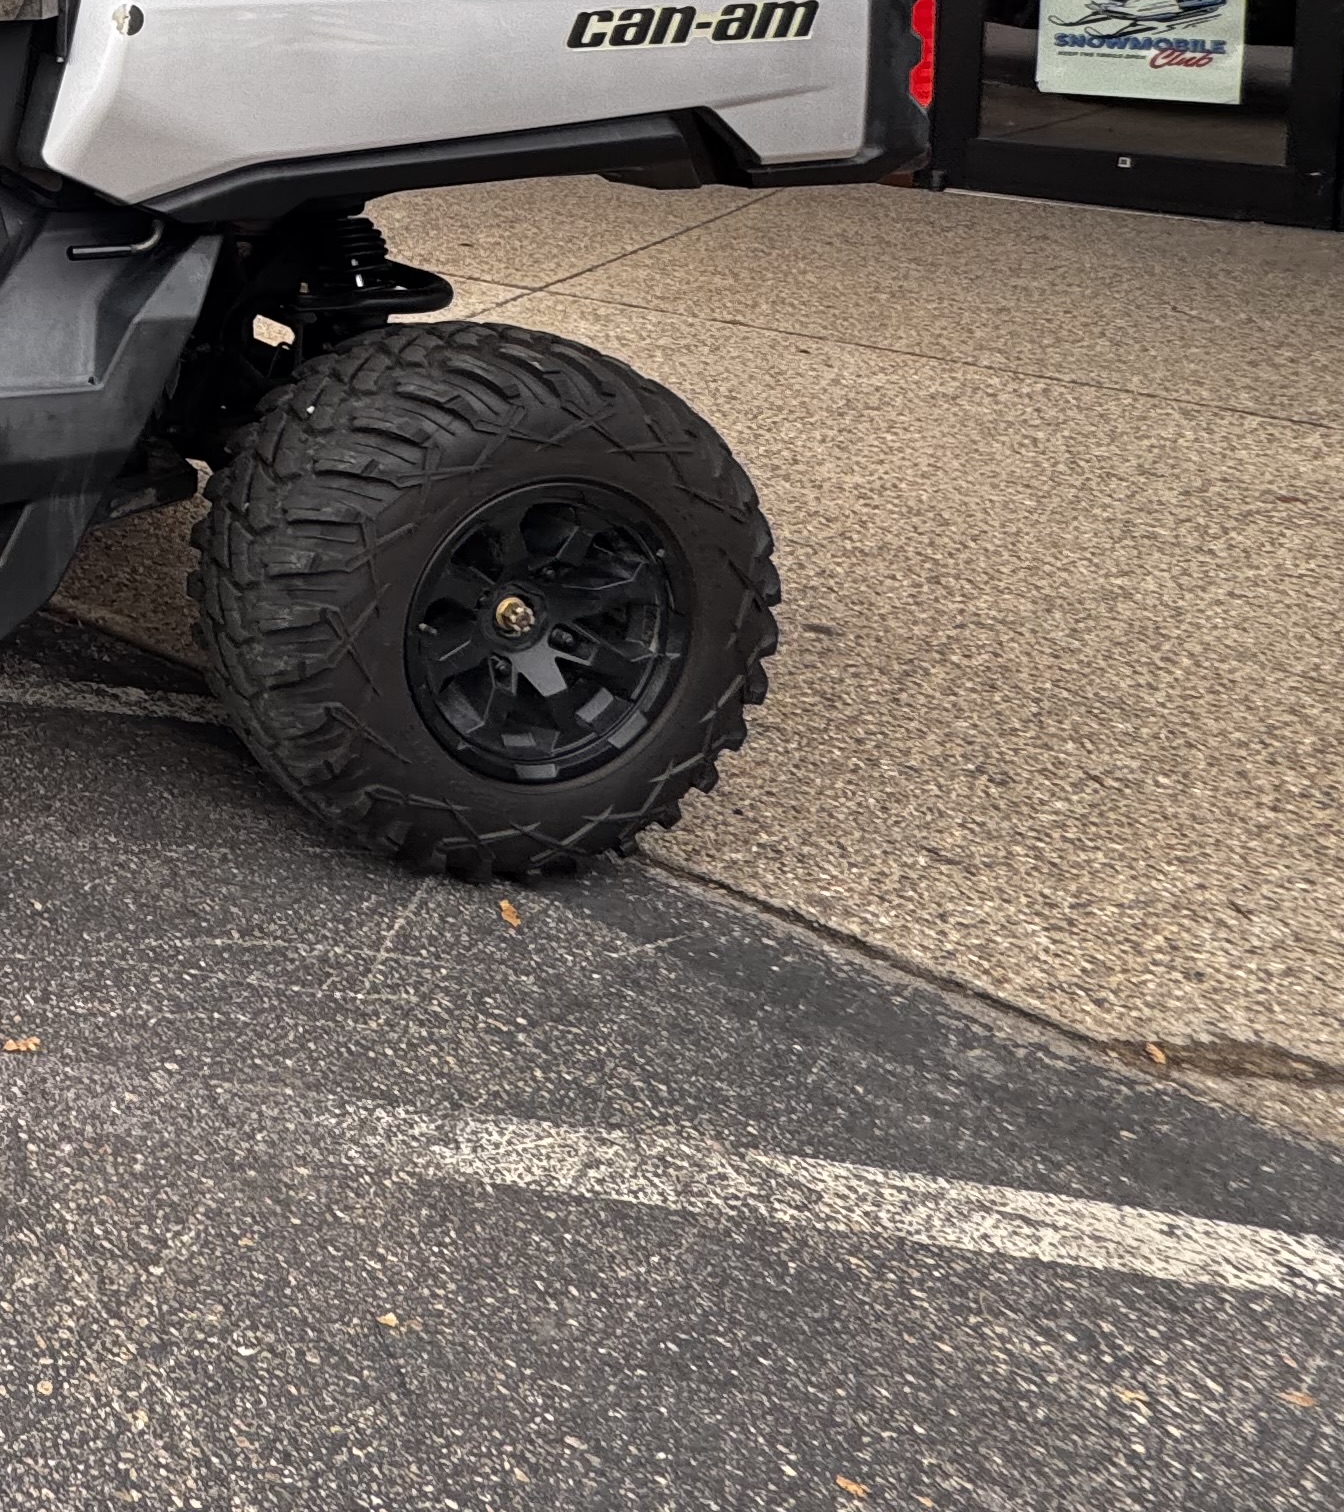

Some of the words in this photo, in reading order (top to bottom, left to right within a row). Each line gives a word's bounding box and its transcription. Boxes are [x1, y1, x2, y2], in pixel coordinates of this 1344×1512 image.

[567, 0, 820, 49] can-am
[1054, 32, 1228, 54] SNOWMOBILE
[1149, 47, 1214, 69] Club
